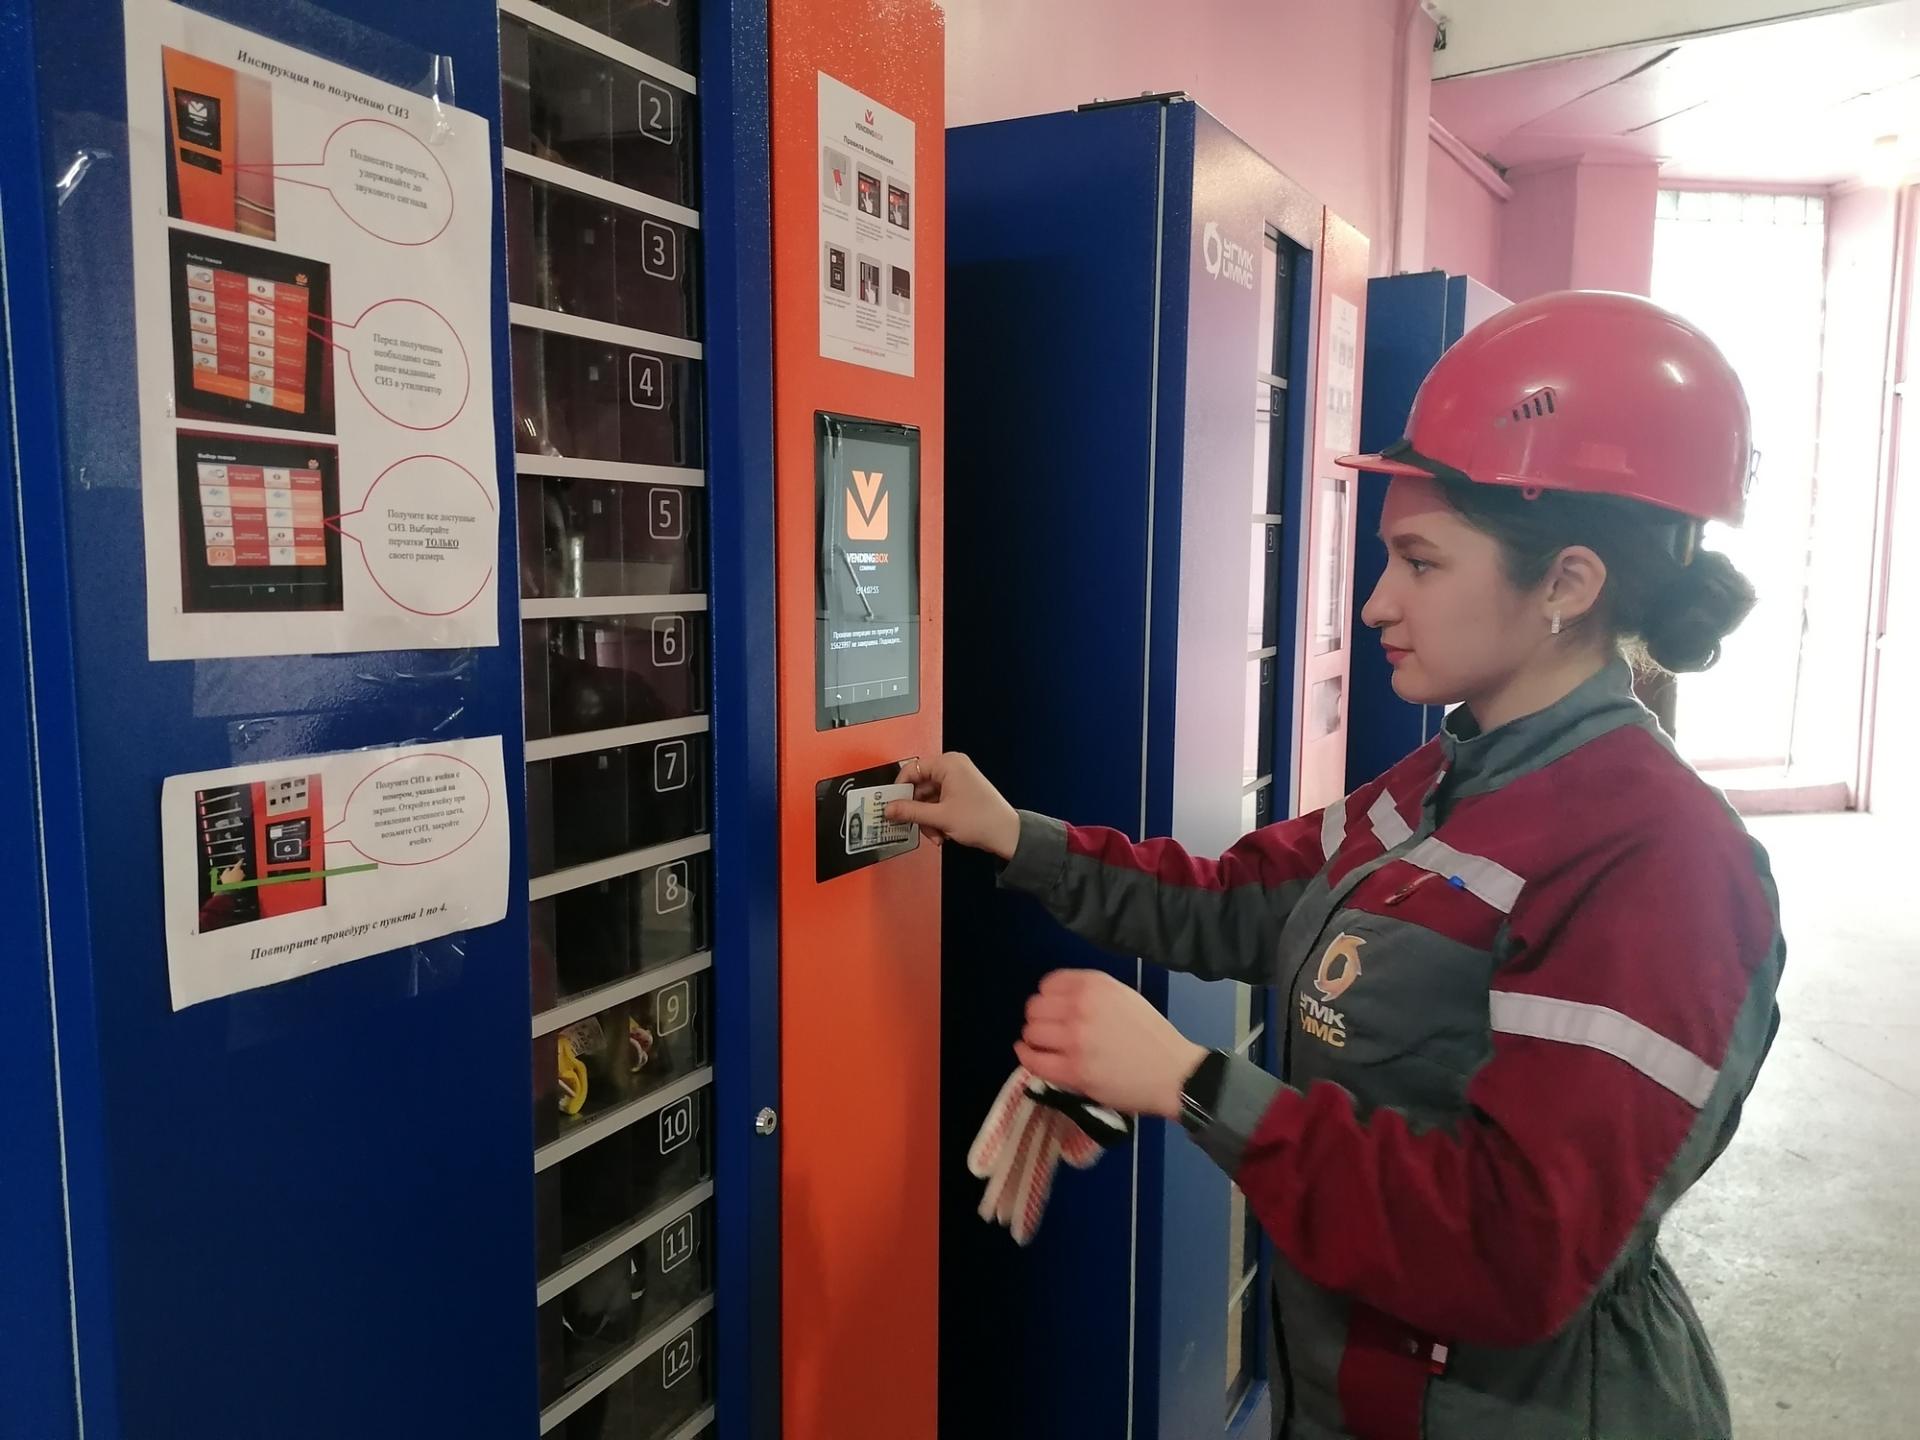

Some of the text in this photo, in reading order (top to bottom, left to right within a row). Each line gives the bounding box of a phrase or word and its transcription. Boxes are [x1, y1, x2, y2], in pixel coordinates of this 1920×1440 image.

[237, 50, 409, 120] Инструкция по получению СИЗ
[650, 96, 662, 130] 2
[652, 236, 665, 266] 3
[1224, 238, 1254, 272] УГМК
[373, 333, 398, 346] Перед
[375, 376, 392, 386] СИЗ
[640, 367, 654, 397] 4
[388, 509, 424, 521] Получите
[660, 500, 670, 528] 5
[425, 538, 460, 548] ТОЛЬКО
[846, 552, 888, 564] VENDINGBOX
[663, 627, 676, 655] 6
[665, 752, 677, 780] 7
[376, 778, 409, 790] Получите
[666, 874, 678, 901] 8
[250, 903, 447, 960] Повторите процедуру с пункта 1 по 4.
[666, 995, 680, 1023] 9
[664, 1111, 687, 1143] 10
[666, 1226, 688, 1261] 11
[668, 1340, 689, 1376] 12
